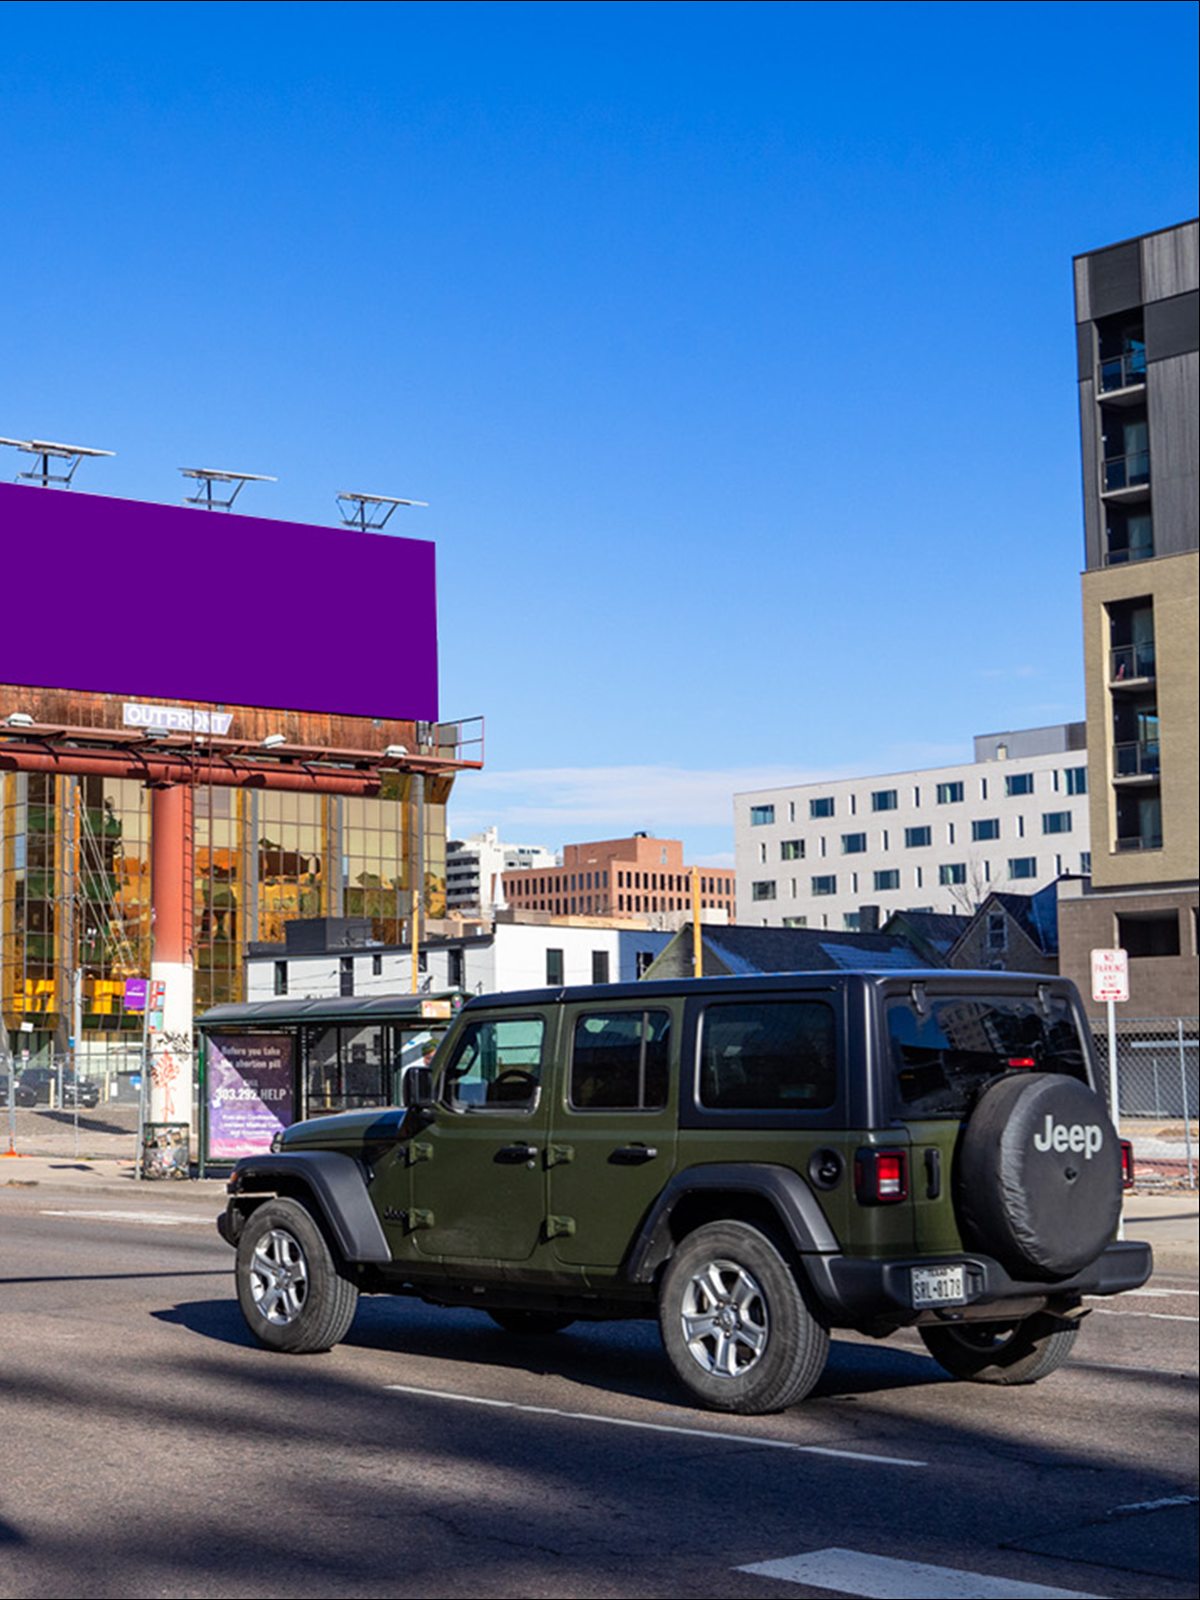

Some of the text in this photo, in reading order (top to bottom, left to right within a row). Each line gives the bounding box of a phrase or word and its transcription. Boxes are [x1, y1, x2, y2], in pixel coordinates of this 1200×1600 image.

[127, 706, 227, 732] OUTFRONT
[1103, 954, 1115, 963] NO
[1094, 963, 1126, 973] PARKING
[221, 1045, 281, 1057] Before you take
[235, 1059, 267, 1069] abortion
[268, 1059, 281, 1070] pill
[1033, 1114, 1103, 1160] Jeep
